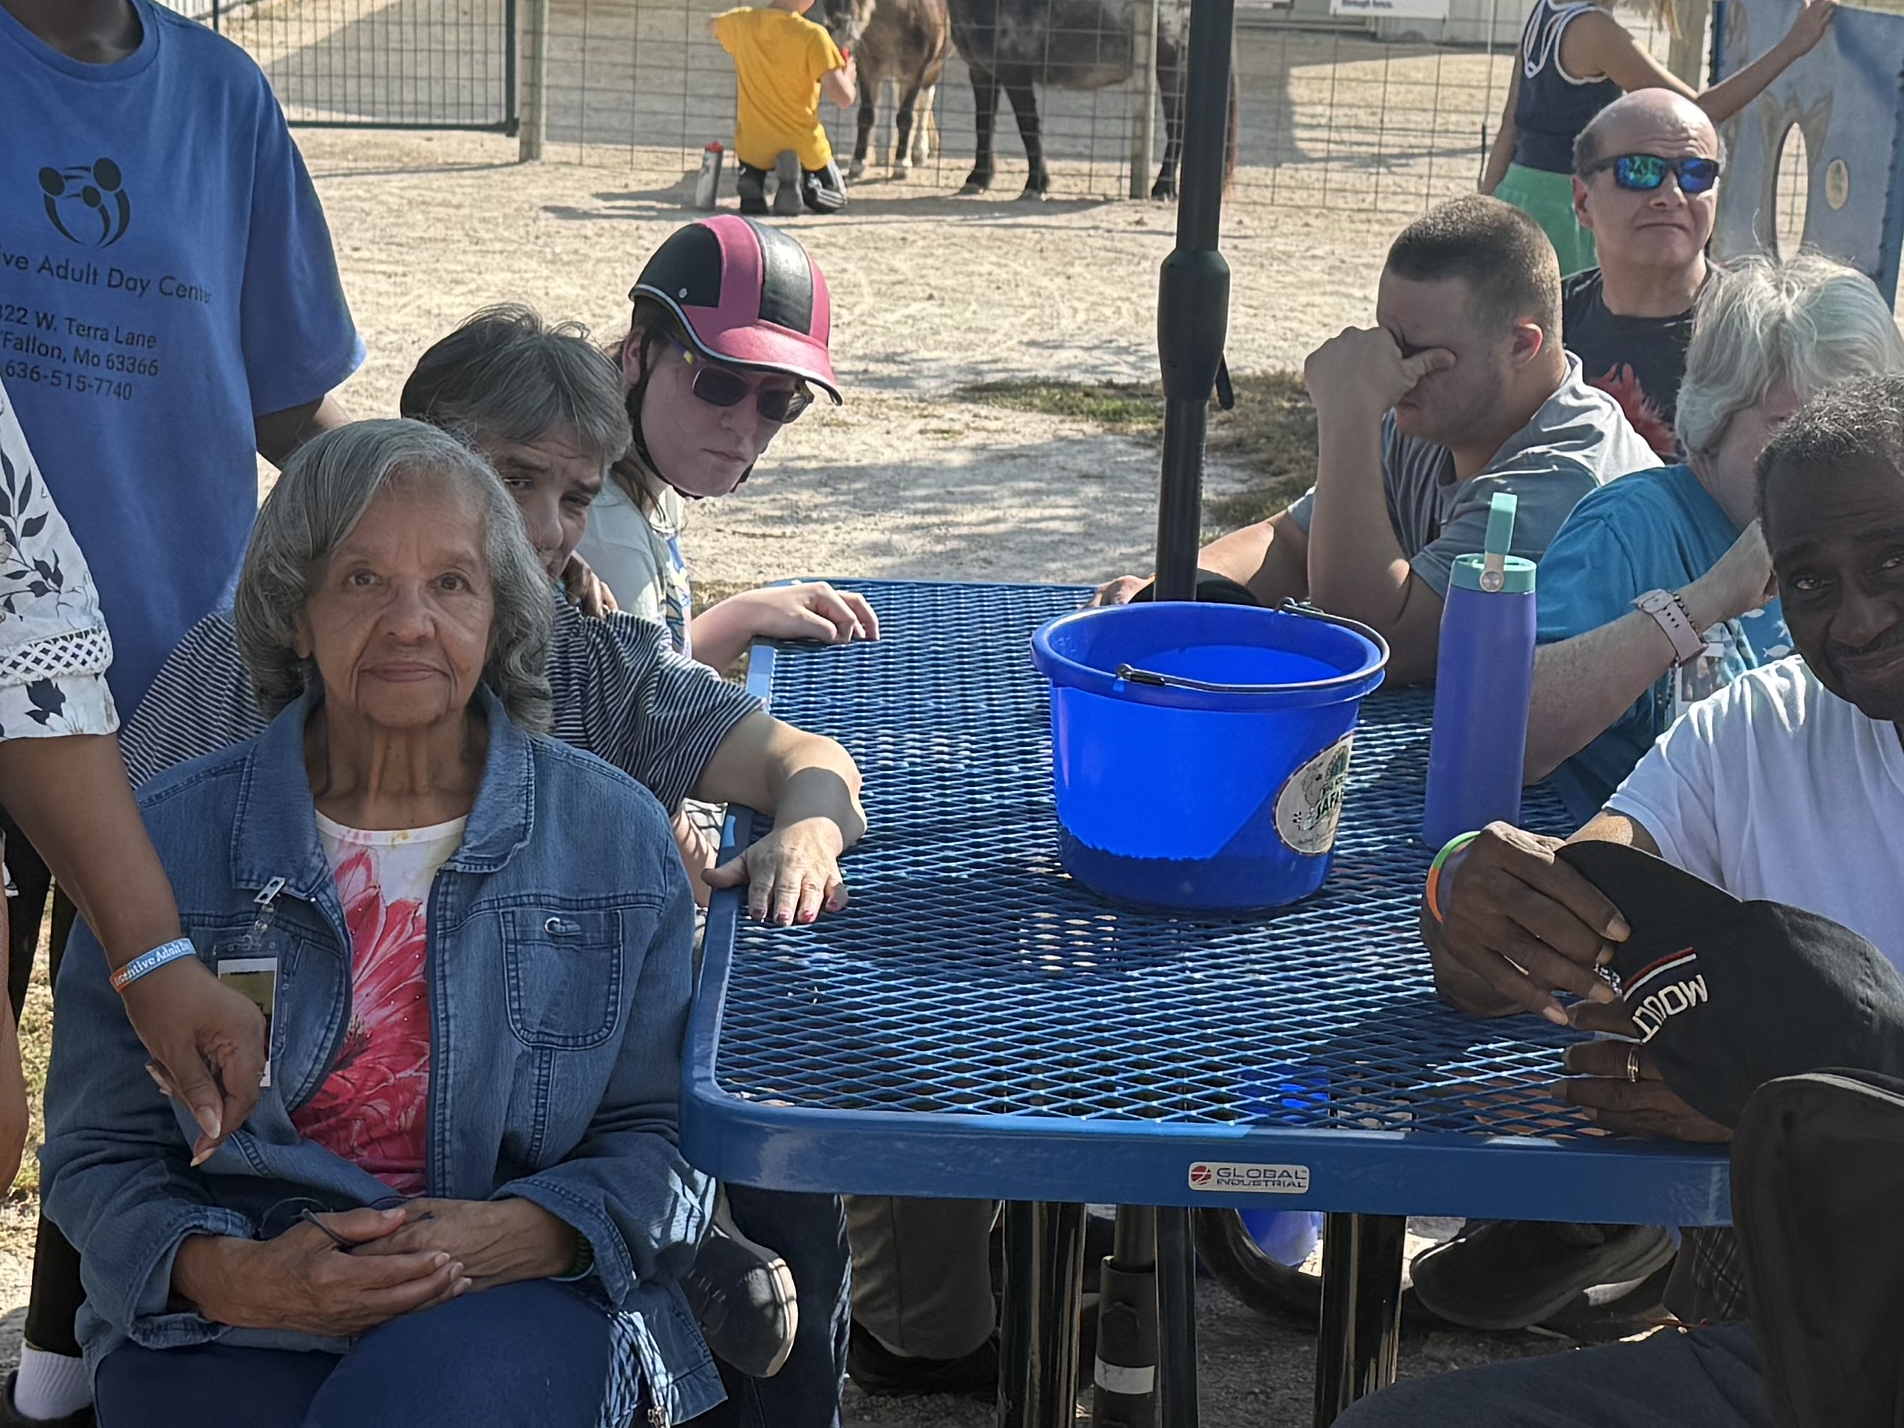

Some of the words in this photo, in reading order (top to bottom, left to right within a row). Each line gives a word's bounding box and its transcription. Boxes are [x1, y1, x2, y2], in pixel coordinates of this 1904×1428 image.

[37, 255, 98, 286] Adult
[107, 267, 152, 299] Day
[36, 311, 58, 332] W.
[64, 317, 110, 342] Terra
[115, 325, 157, 349] Lane
[73, 346, 101, 367] Mo
[106, 353, 160, 376] 63366
[5, 359, 133, 401] 636-515-7740
[1216, 1166, 1308, 1180] GLOBAL
[1216, 1178, 1307, 1189] INDUSTRIAL
